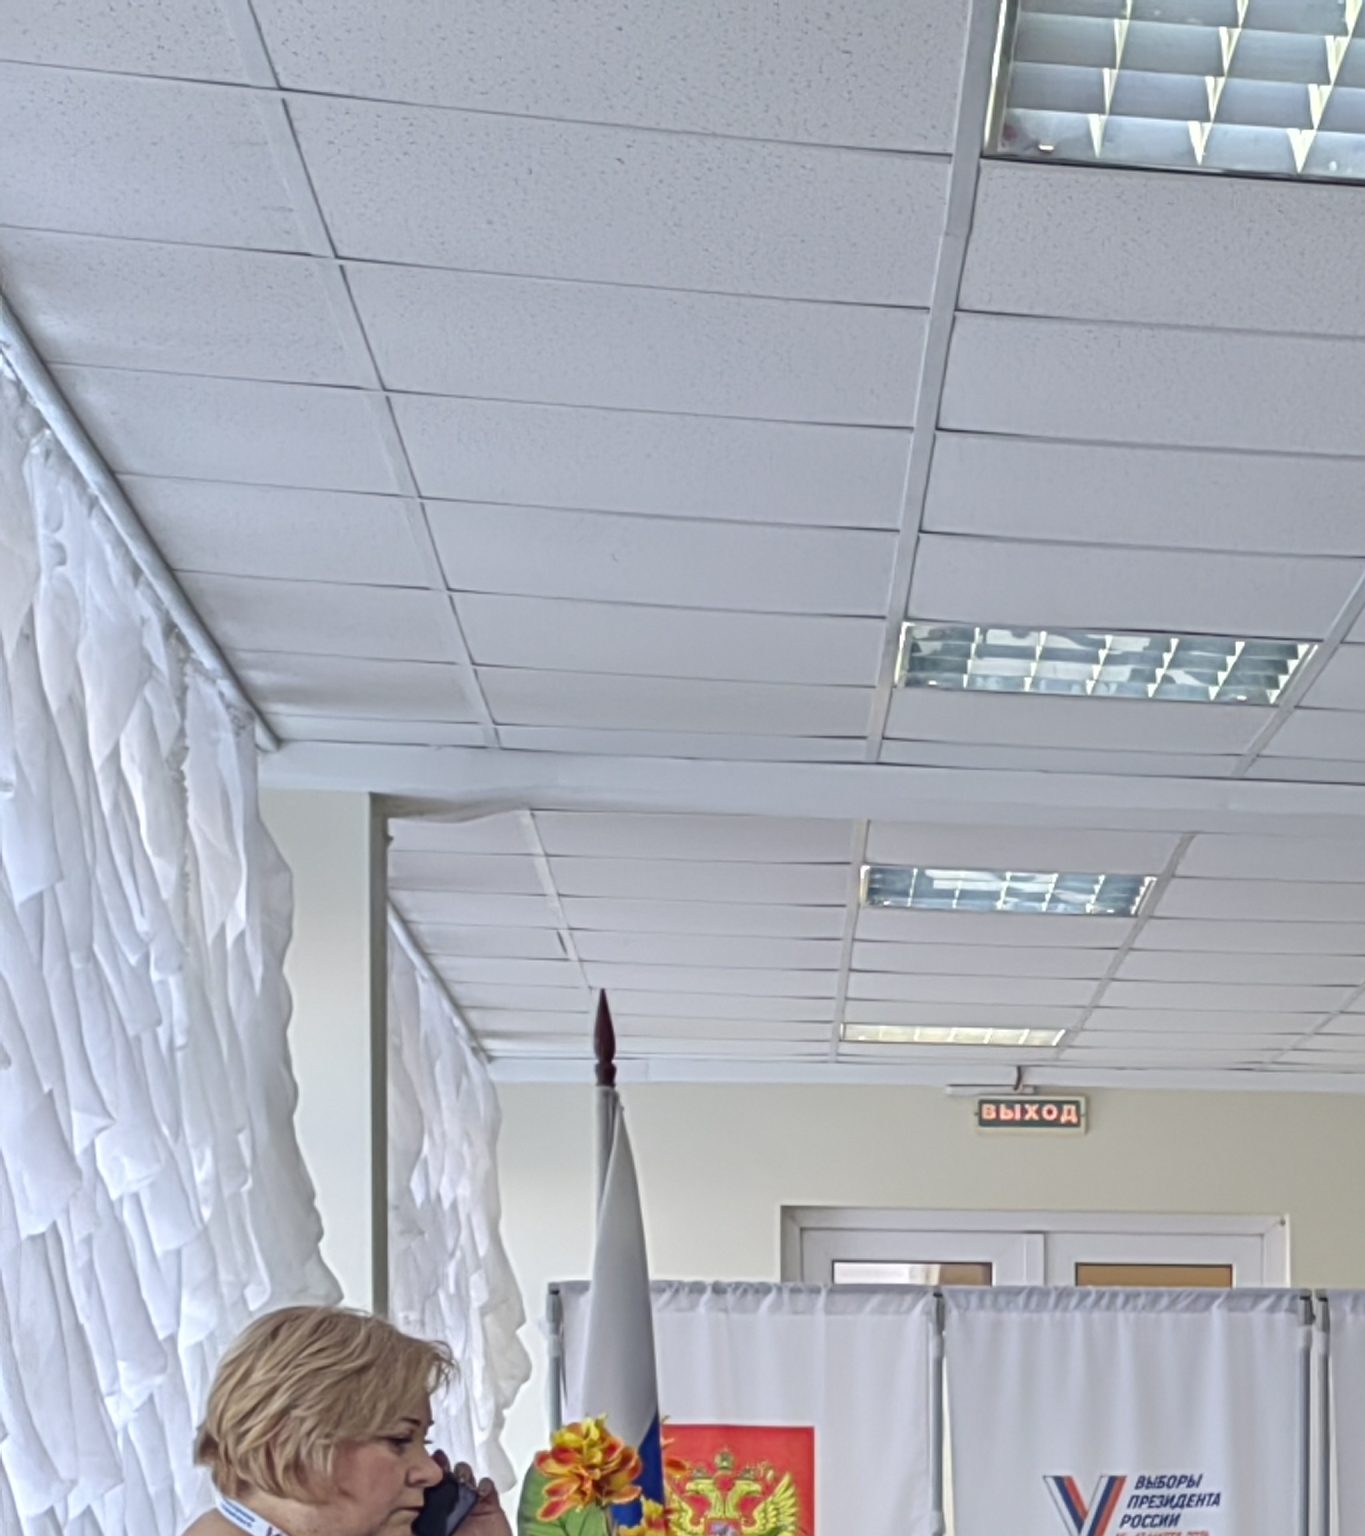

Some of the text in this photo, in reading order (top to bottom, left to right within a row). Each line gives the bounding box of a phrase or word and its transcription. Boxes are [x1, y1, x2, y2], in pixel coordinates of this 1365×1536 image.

[982, 1104, 1078, 1124] ВЫХОД
[1134, 1474, 1203, 1490] ВЫБОРЫ
[1127, 1492, 1221, 1510] ПРЕЗИДЕНТА
[1119, 1513, 1181, 1528] РОССИИ
